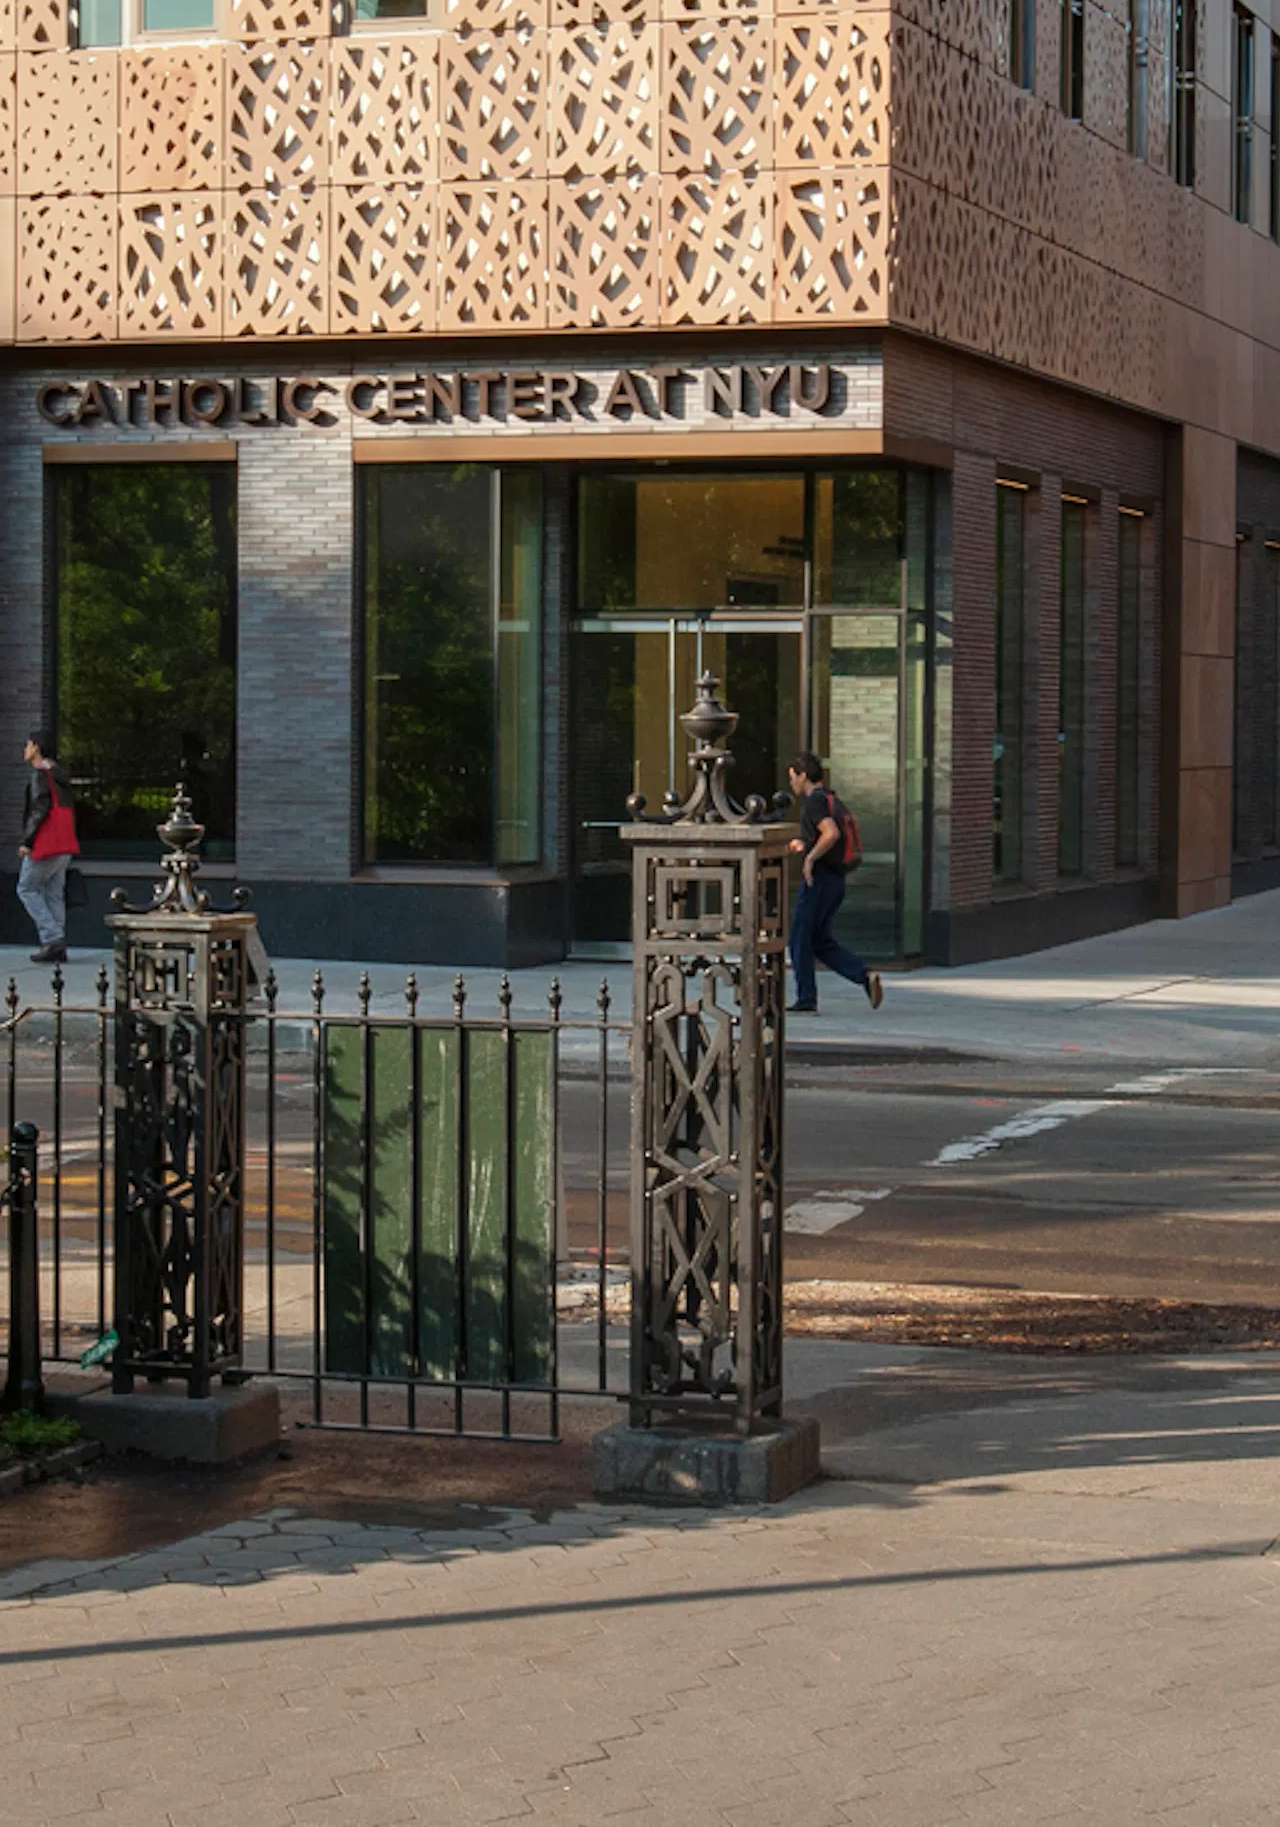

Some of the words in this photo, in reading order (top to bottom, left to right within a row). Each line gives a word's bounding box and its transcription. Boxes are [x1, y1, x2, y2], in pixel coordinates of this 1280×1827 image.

[36, 377, 322, 424] CATHOLIC
[344, 371, 582, 420] CENTER
[604, 367, 681, 415] AT
[703, 364, 830, 412] NYU
